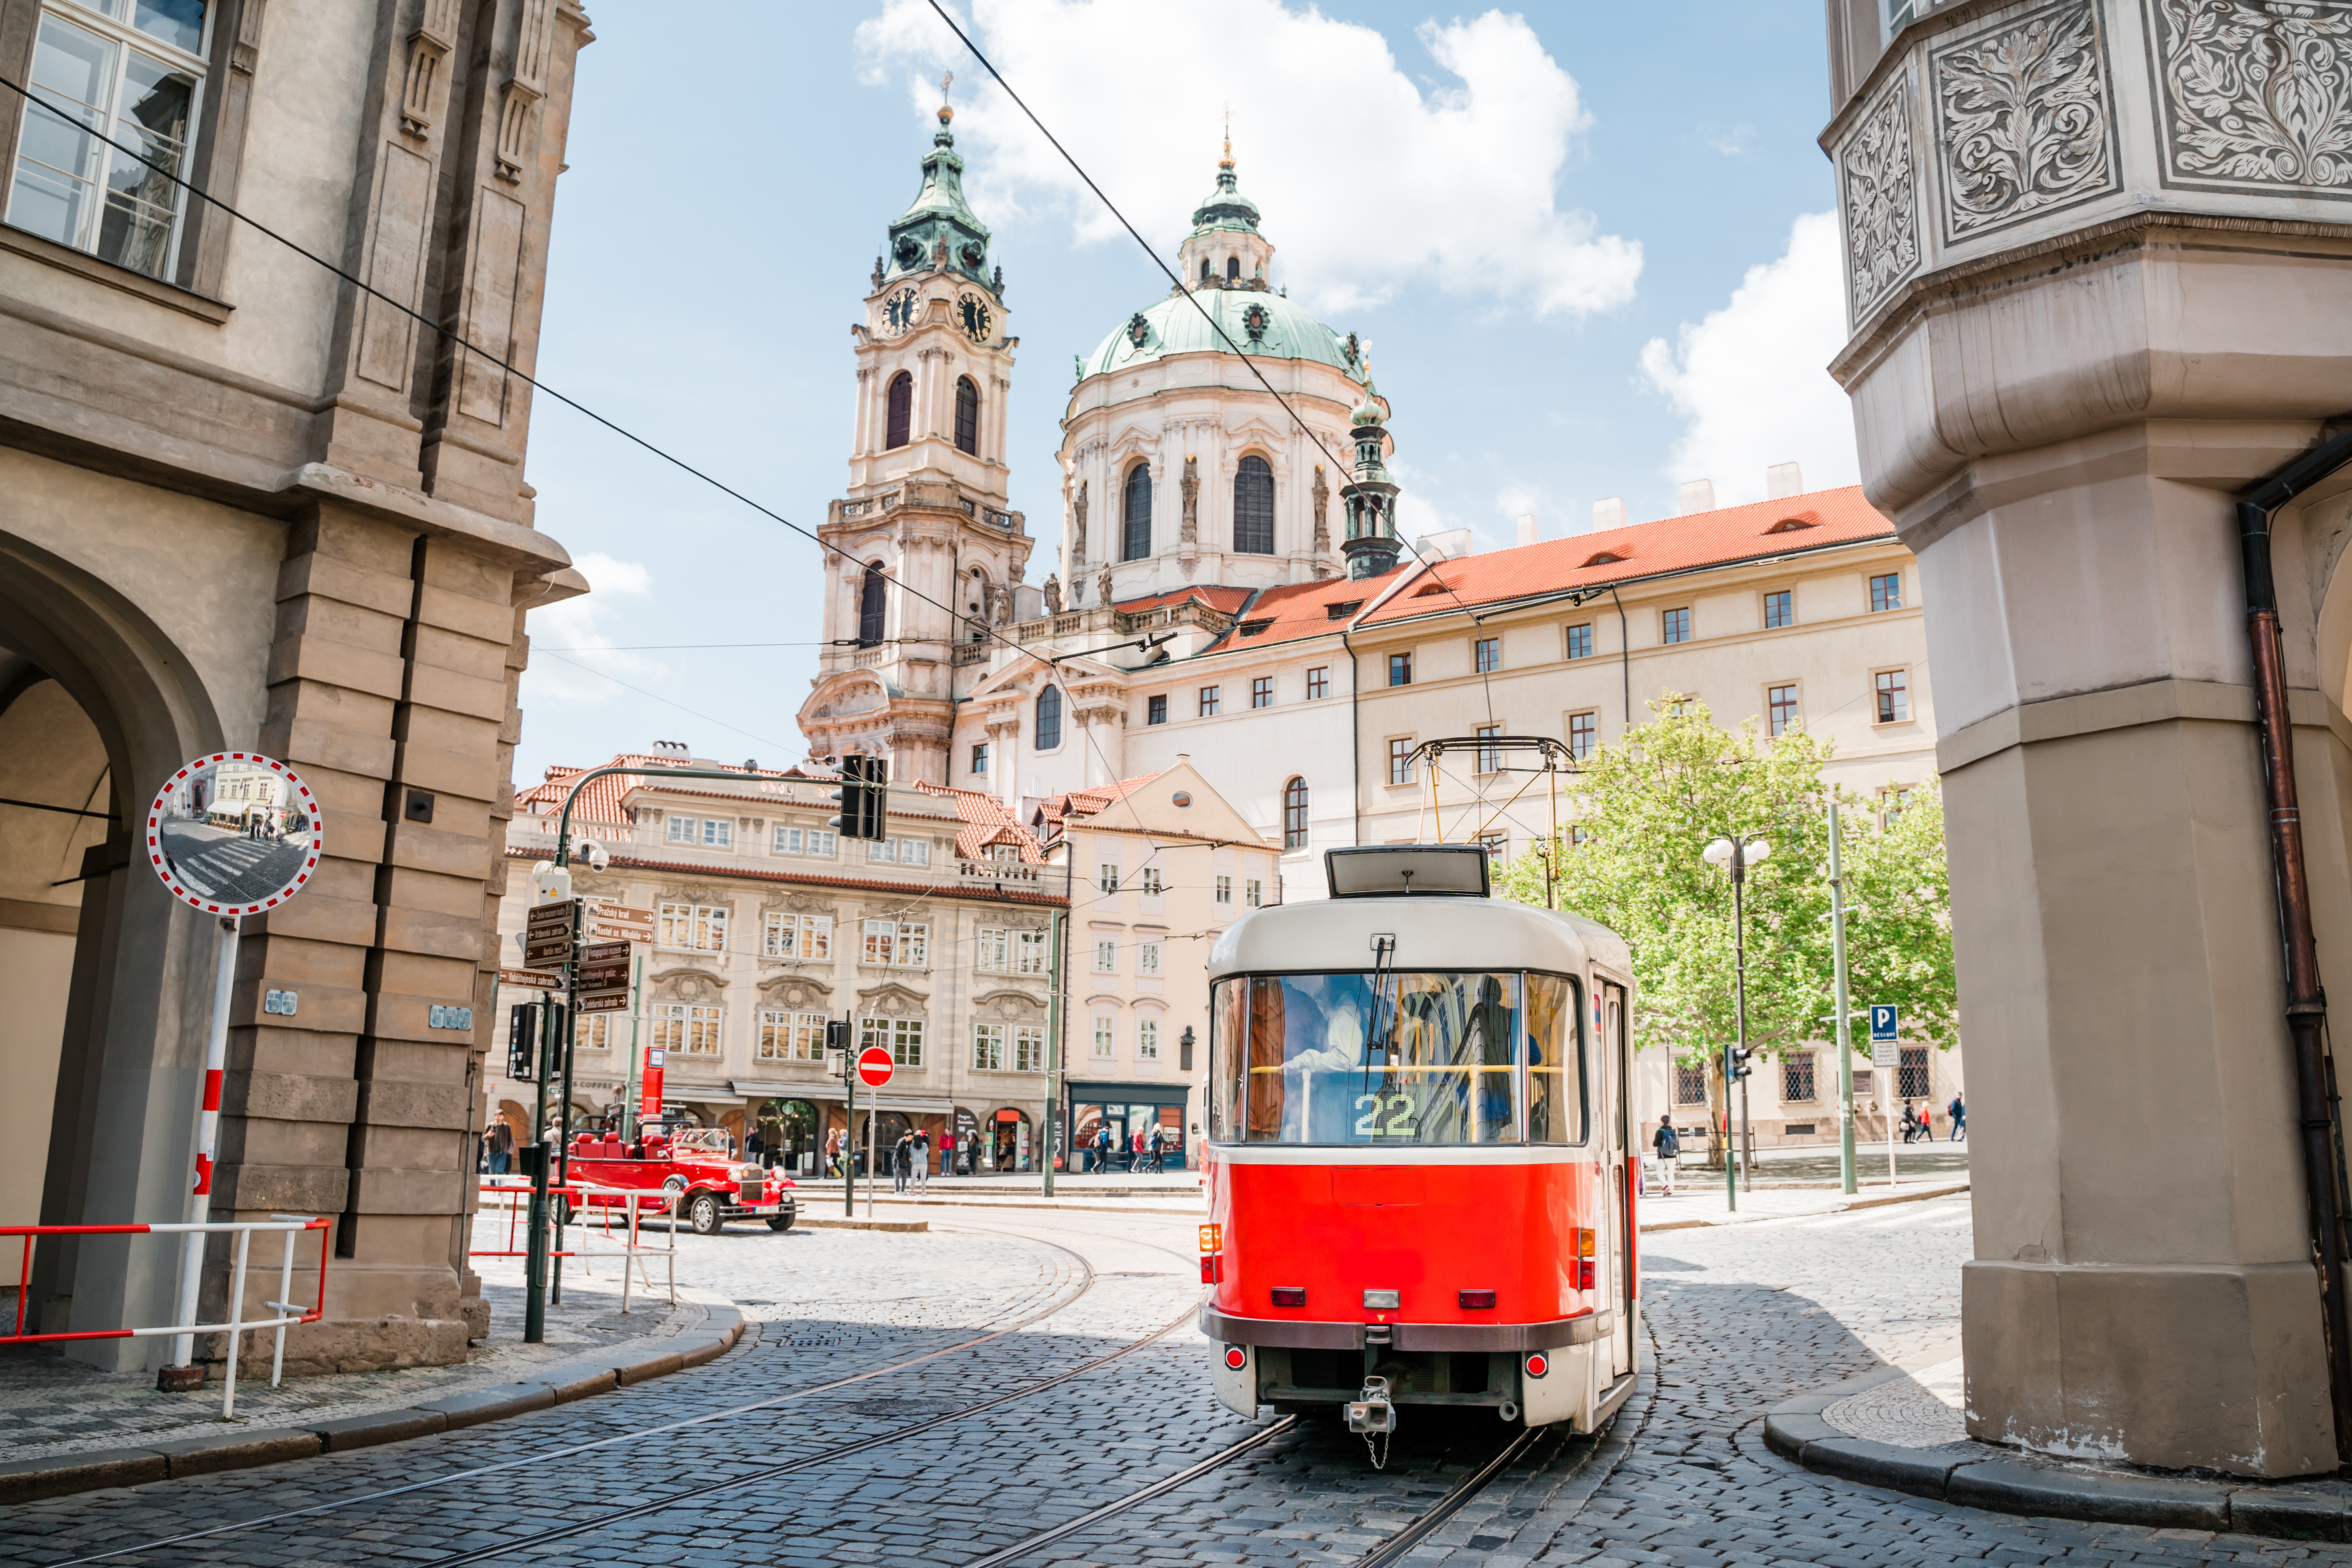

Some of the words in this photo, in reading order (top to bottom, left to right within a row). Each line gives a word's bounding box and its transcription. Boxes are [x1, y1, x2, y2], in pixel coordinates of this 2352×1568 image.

[599, 906, 617, 919] Pražský
[618, 909, 629, 919] hrad
[551, 926, 564, 936] zahrada
[597, 926, 612, 936] Kostel
[621, 929, 641, 940] Mikuláše
[554, 945, 562, 954] most
[508, 971, 537, 985] Valdštejnská
[537, 976, 555, 986] zahrada
[605, 968, 616, 980] palác
[585, 998, 603, 1009] Ledeburská
[604, 997, 617, 1007] zahrada
[1877, 1008, 1890, 1028] P
[1355, 1094, 1415, 1135] 22
